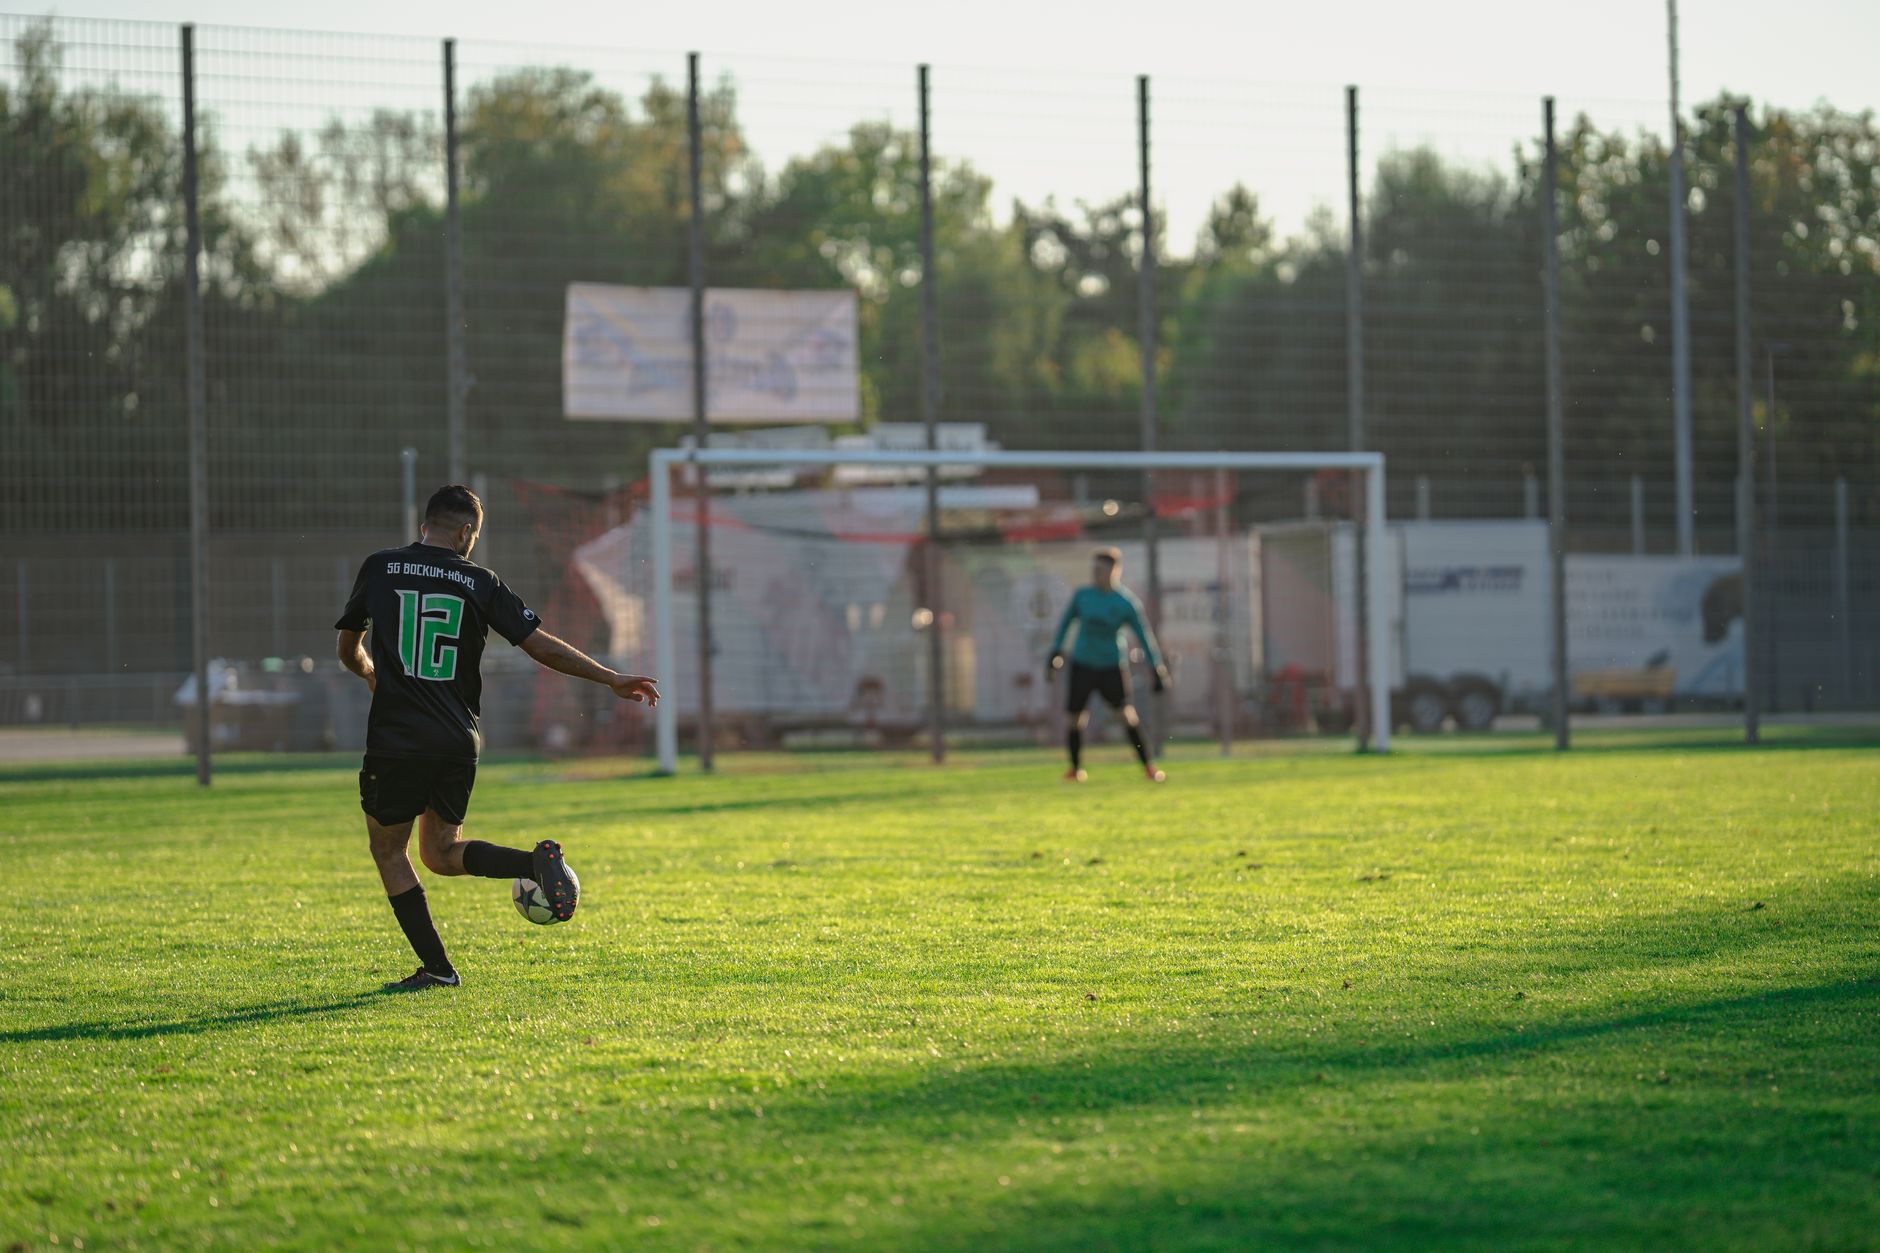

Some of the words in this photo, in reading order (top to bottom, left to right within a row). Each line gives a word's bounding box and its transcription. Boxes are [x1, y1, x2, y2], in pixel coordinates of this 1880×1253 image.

[387, 562, 401, 574] SG
[403, 563, 475, 590] BOCKUM-HÖVEL
[394, 589, 465, 681] 12
